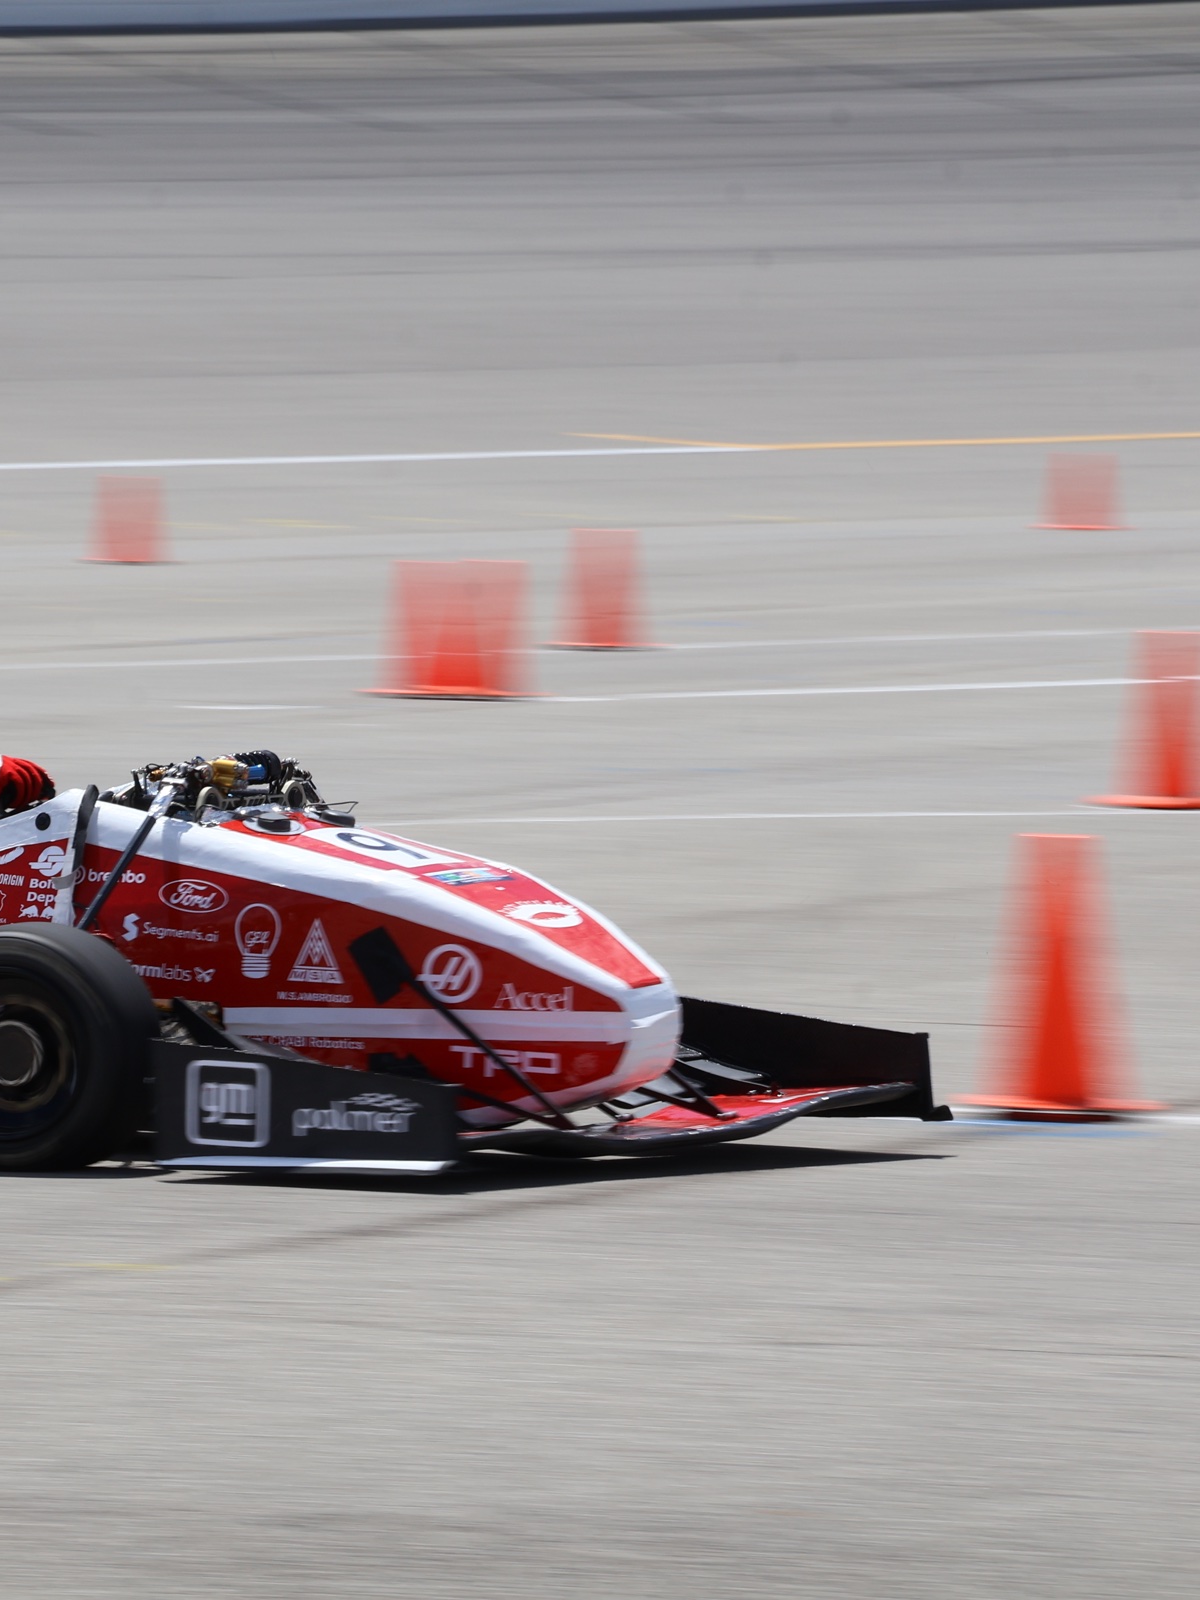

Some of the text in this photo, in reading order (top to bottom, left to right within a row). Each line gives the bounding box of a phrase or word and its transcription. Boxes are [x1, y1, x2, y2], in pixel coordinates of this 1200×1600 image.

[336, 832, 430, 860] 9
[88, 869, 146, 884] brebo
[26, 891, 56, 906] Dep
[170, 882, 218, 909] Ford
[142, 922, 219, 942] Segments.ai
[492, 982, 574, 1012] Accel
[291, 1100, 417, 1137] palmer
